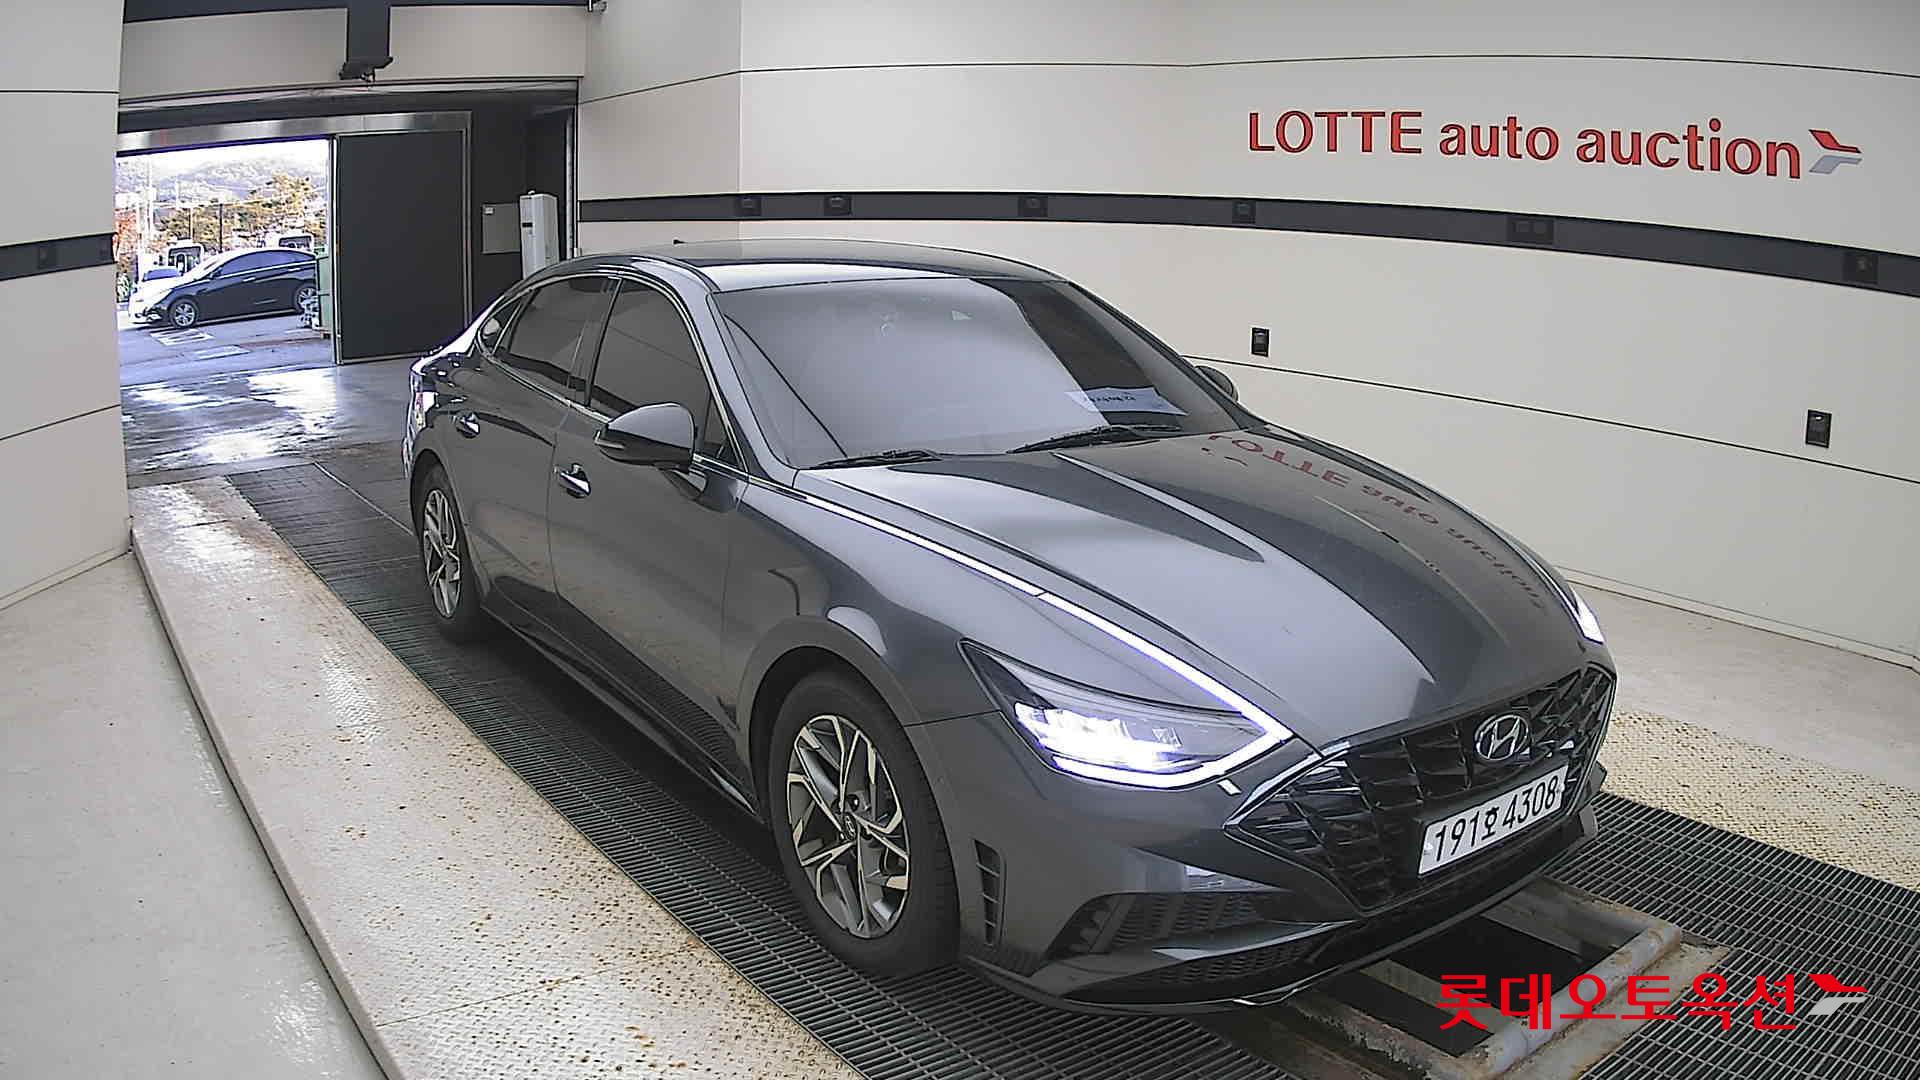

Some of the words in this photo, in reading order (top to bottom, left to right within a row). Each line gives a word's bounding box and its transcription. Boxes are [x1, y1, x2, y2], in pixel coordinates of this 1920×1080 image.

[1248, 110, 1423, 154] LOTTE
[1439, 116, 1559, 161] auto
[1575, 118, 1801, 179] auction
